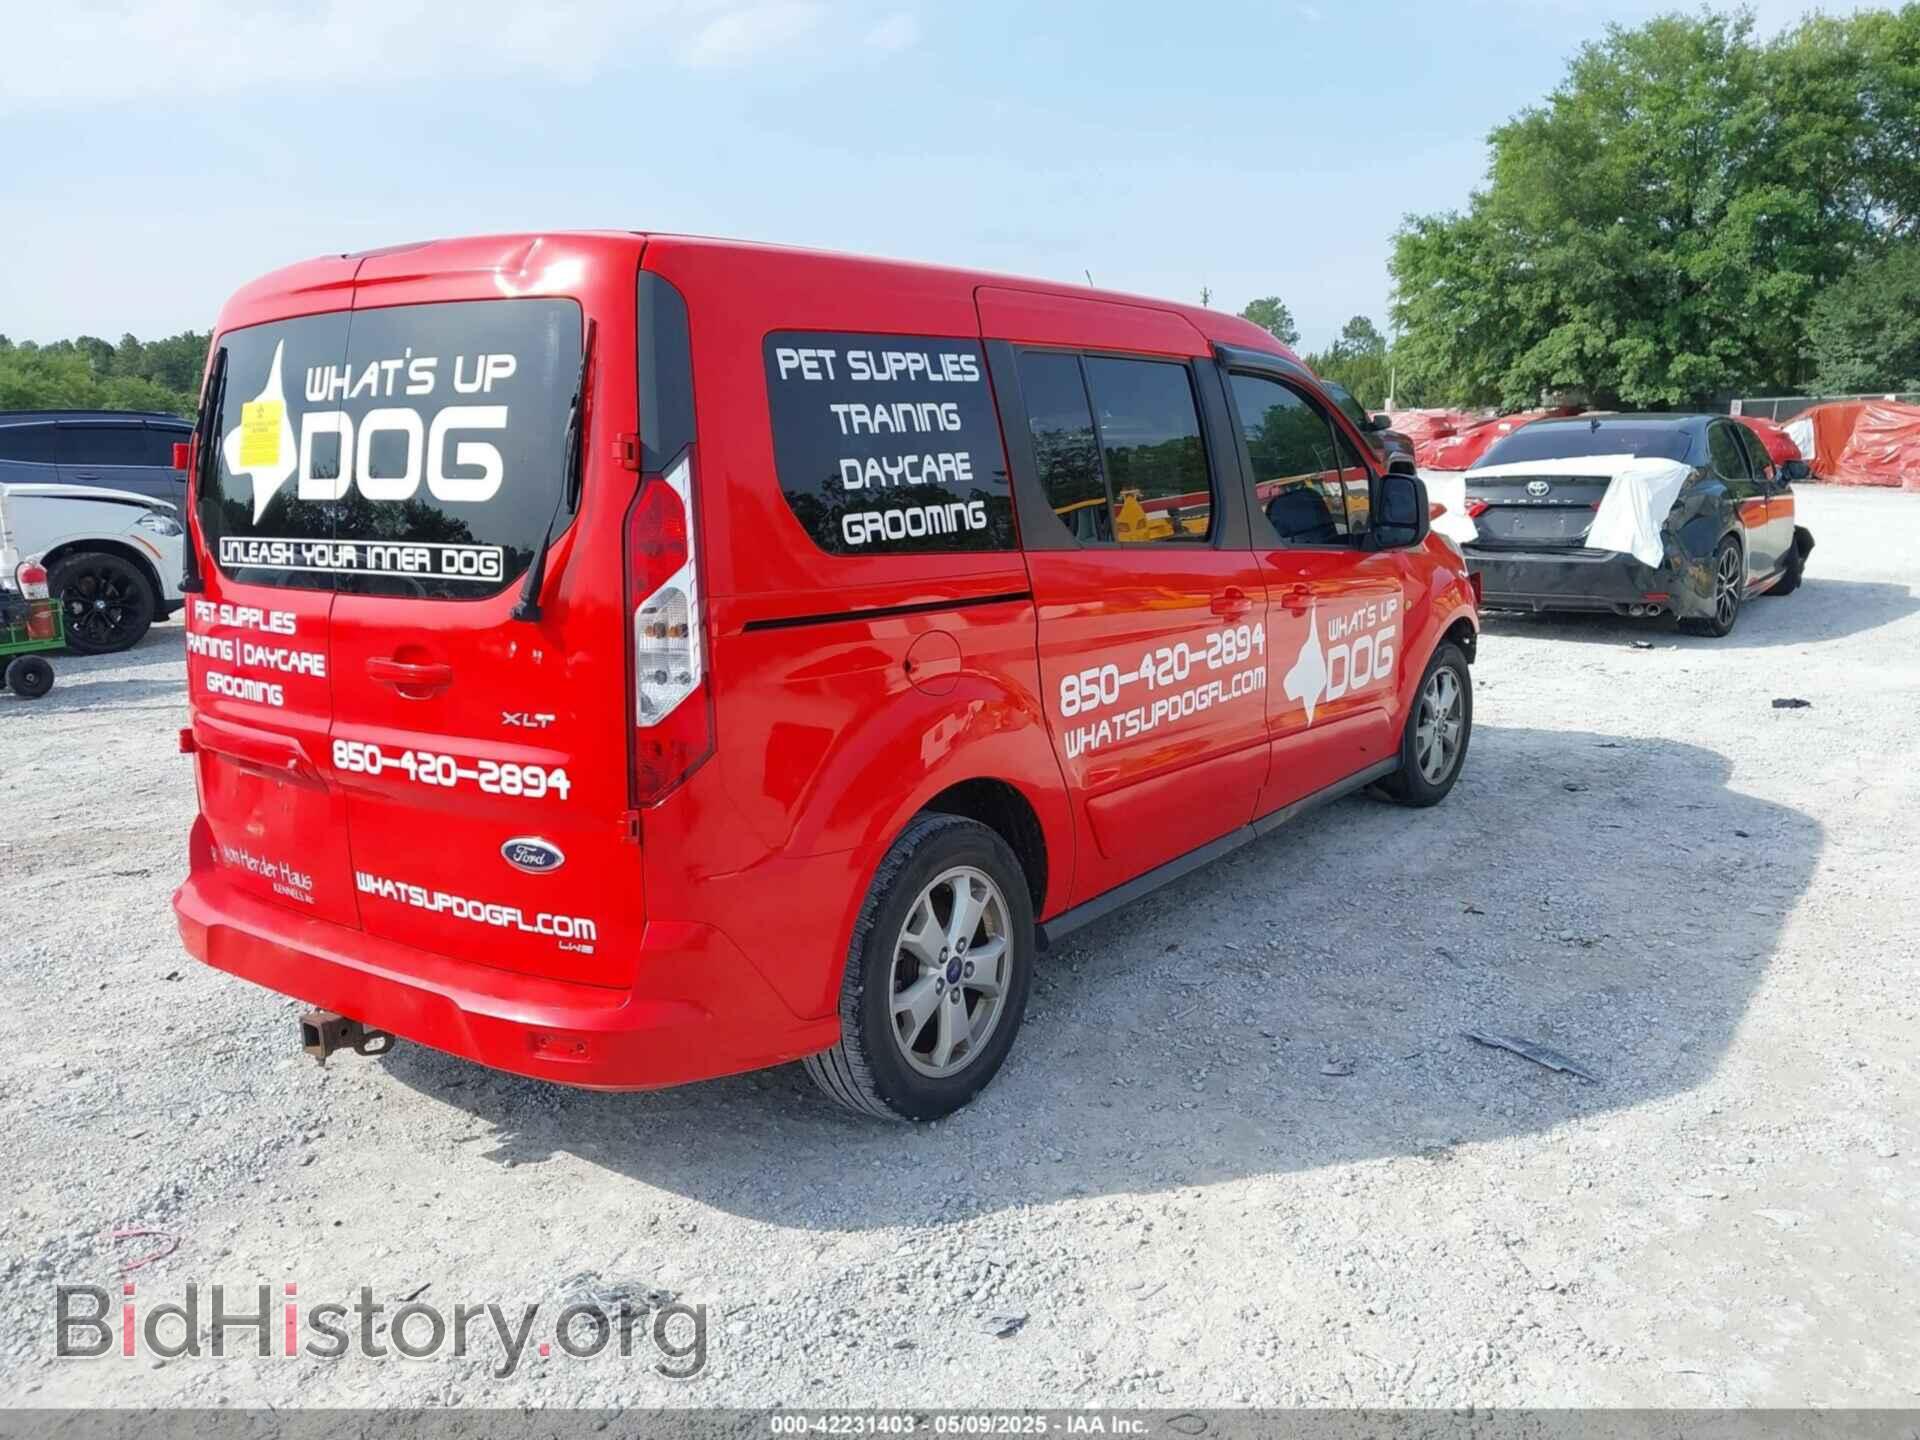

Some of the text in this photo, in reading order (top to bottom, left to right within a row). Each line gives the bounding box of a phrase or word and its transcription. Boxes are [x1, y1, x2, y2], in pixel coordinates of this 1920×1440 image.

[305, 347, 517, 401] WHAT'S UP
[775, 347, 980, 382] PET SUPPLIES
[830, 402, 961, 434] TRAINING
[298, 406, 509, 501] DOG
[839, 451, 974, 490] DAYCARE
[842, 500, 987, 545] GROOMING
[222, 542, 499, 576] UNLEASH YOUR INNER DOG
[194, 600, 296, 635] PET SUPPLIES
[1328, 598, 1398, 641] WHAT'S UP
[243, 643, 326, 678] DAYCARE
[1059, 622, 1265, 719] 850-420-2894
[1326, 624, 1396, 702] DOG
[206, 671, 284, 707] GROOMING
[502, 711, 556, 729] XLT
[1064, 666, 1266, 759] WHATSUPDOGFL.COM
[332, 739, 571, 801] 850-420-2894
[513, 845, 546, 865] Ford
[355, 870, 598, 941] WHATSUPDOGFL.COM
